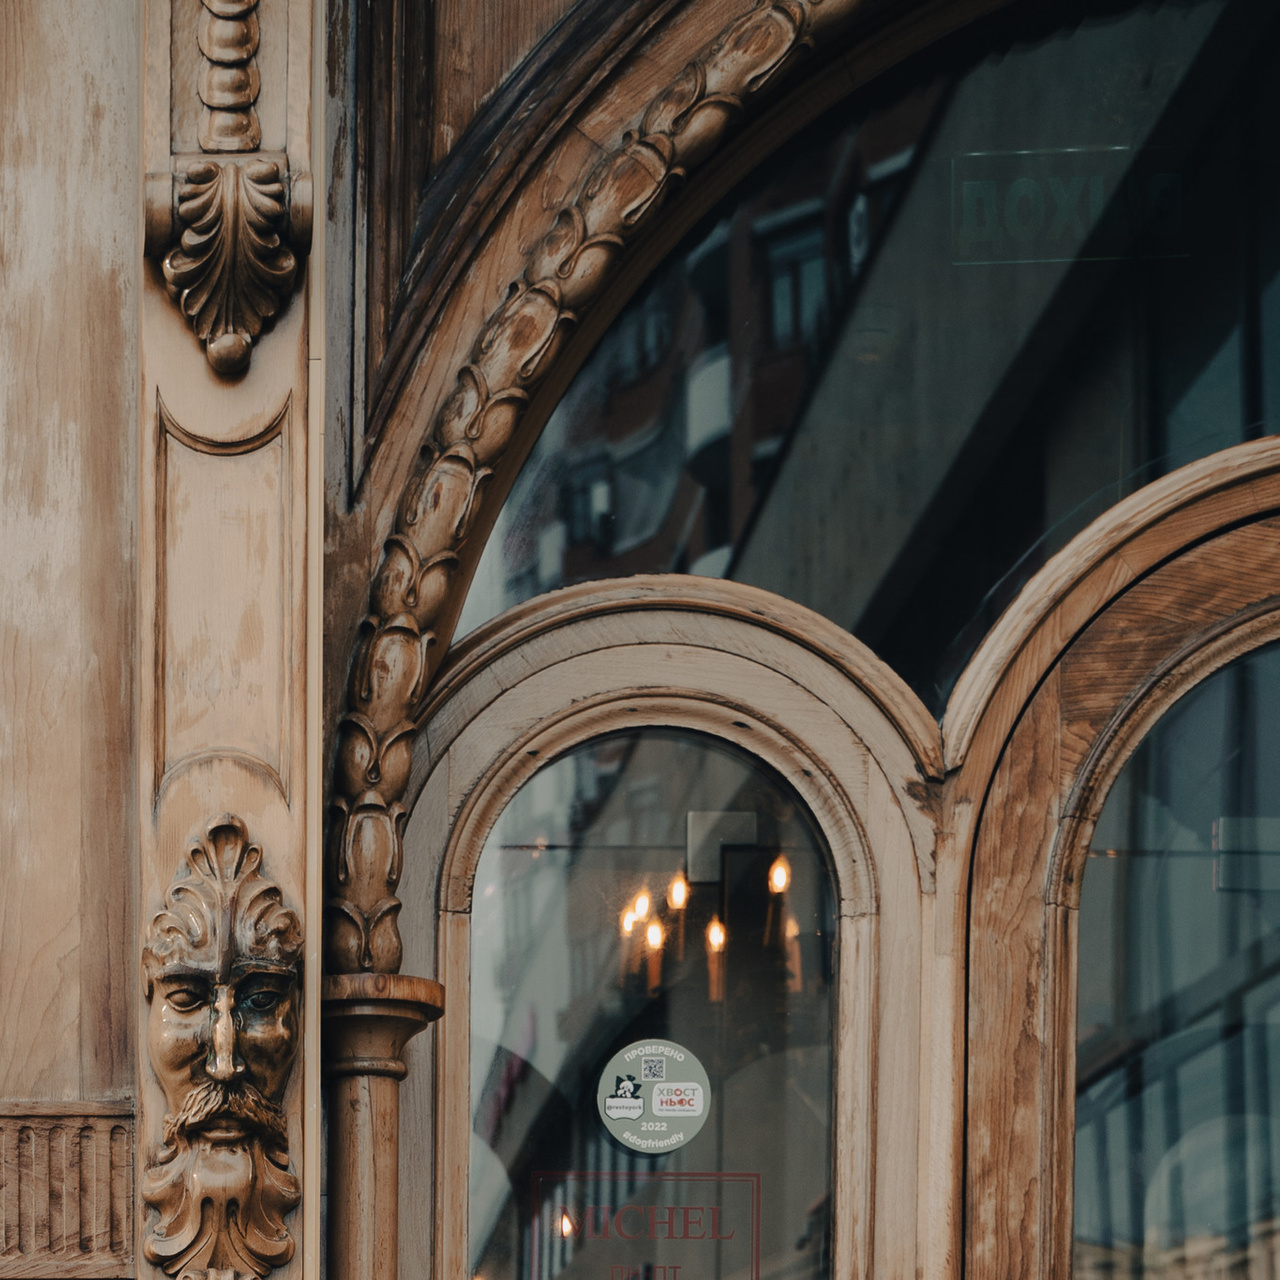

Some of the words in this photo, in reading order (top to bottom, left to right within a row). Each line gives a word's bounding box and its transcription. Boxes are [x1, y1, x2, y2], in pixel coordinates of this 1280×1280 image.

[624, 1045, 685, 1062] ПРОВЕРЕНО
[658, 1088, 698, 1097] ХВОСТ
[640, 1122, 667, 1131] 2022
[623, 1131, 684, 1149] #dogfriendly
[554, 1205, 735, 1240] MICHEL
